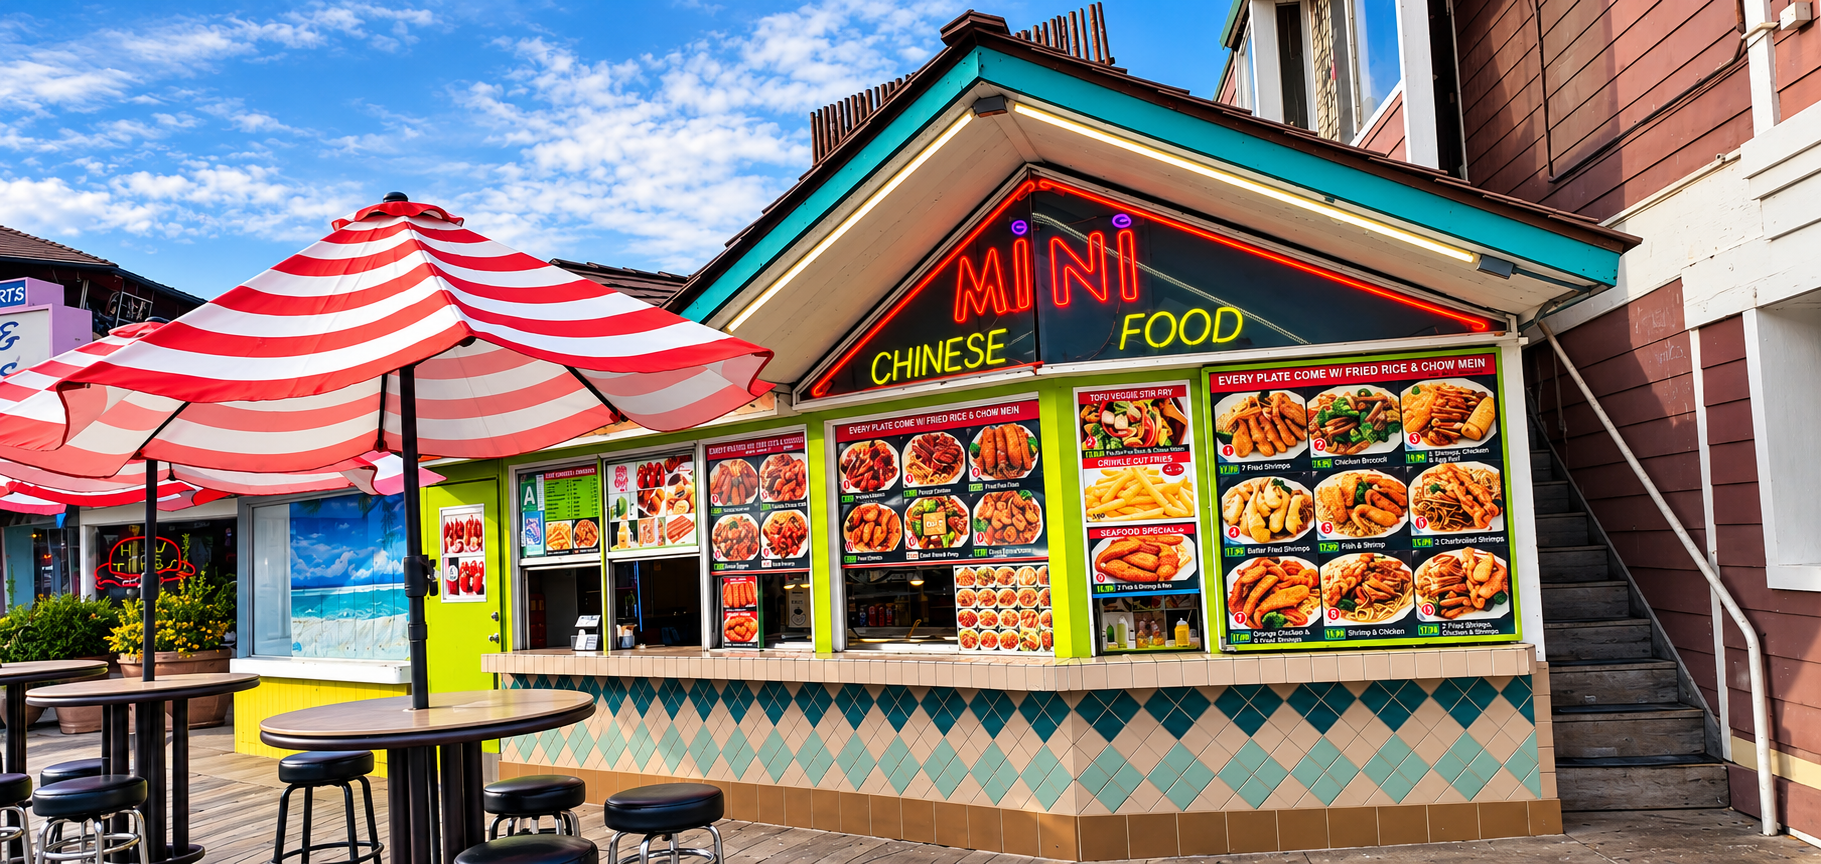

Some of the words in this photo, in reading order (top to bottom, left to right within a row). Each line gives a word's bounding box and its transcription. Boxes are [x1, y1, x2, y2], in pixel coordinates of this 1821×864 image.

[870, 327, 1009, 386] CHINESE
[1118, 306, 1244, 351] FOOD
[1218, 374, 1254, 385] EVERY
[1257, 371, 1291, 383] PLATE
[1294, 369, 1326, 380] COME
[1329, 368, 1343, 378] W/
[1345, 365, 1378, 377] FRIED
[1381, 363, 1408, 374] RICE
[1410, 362, 1419, 372] &
[1421, 360, 1455, 371] CHOW
[1458, 358, 1486, 369] MEIN
[1090, 393, 1110, 402] TOFU
[872, 421, 893, 431] PLATE
[926, 414, 948, 425] FRIED
[949, 412, 967, 422] RICE
[976, 408, 999, 418] CHOW
[1316, 441, 1323, 449] 2
[1133, 456, 1148, 464] CUT
[524, 486, 536, 506] A
[1100, 528, 1140, 537] SEAFOOD
[1142, 527, 1178, 535] SPECIAL
